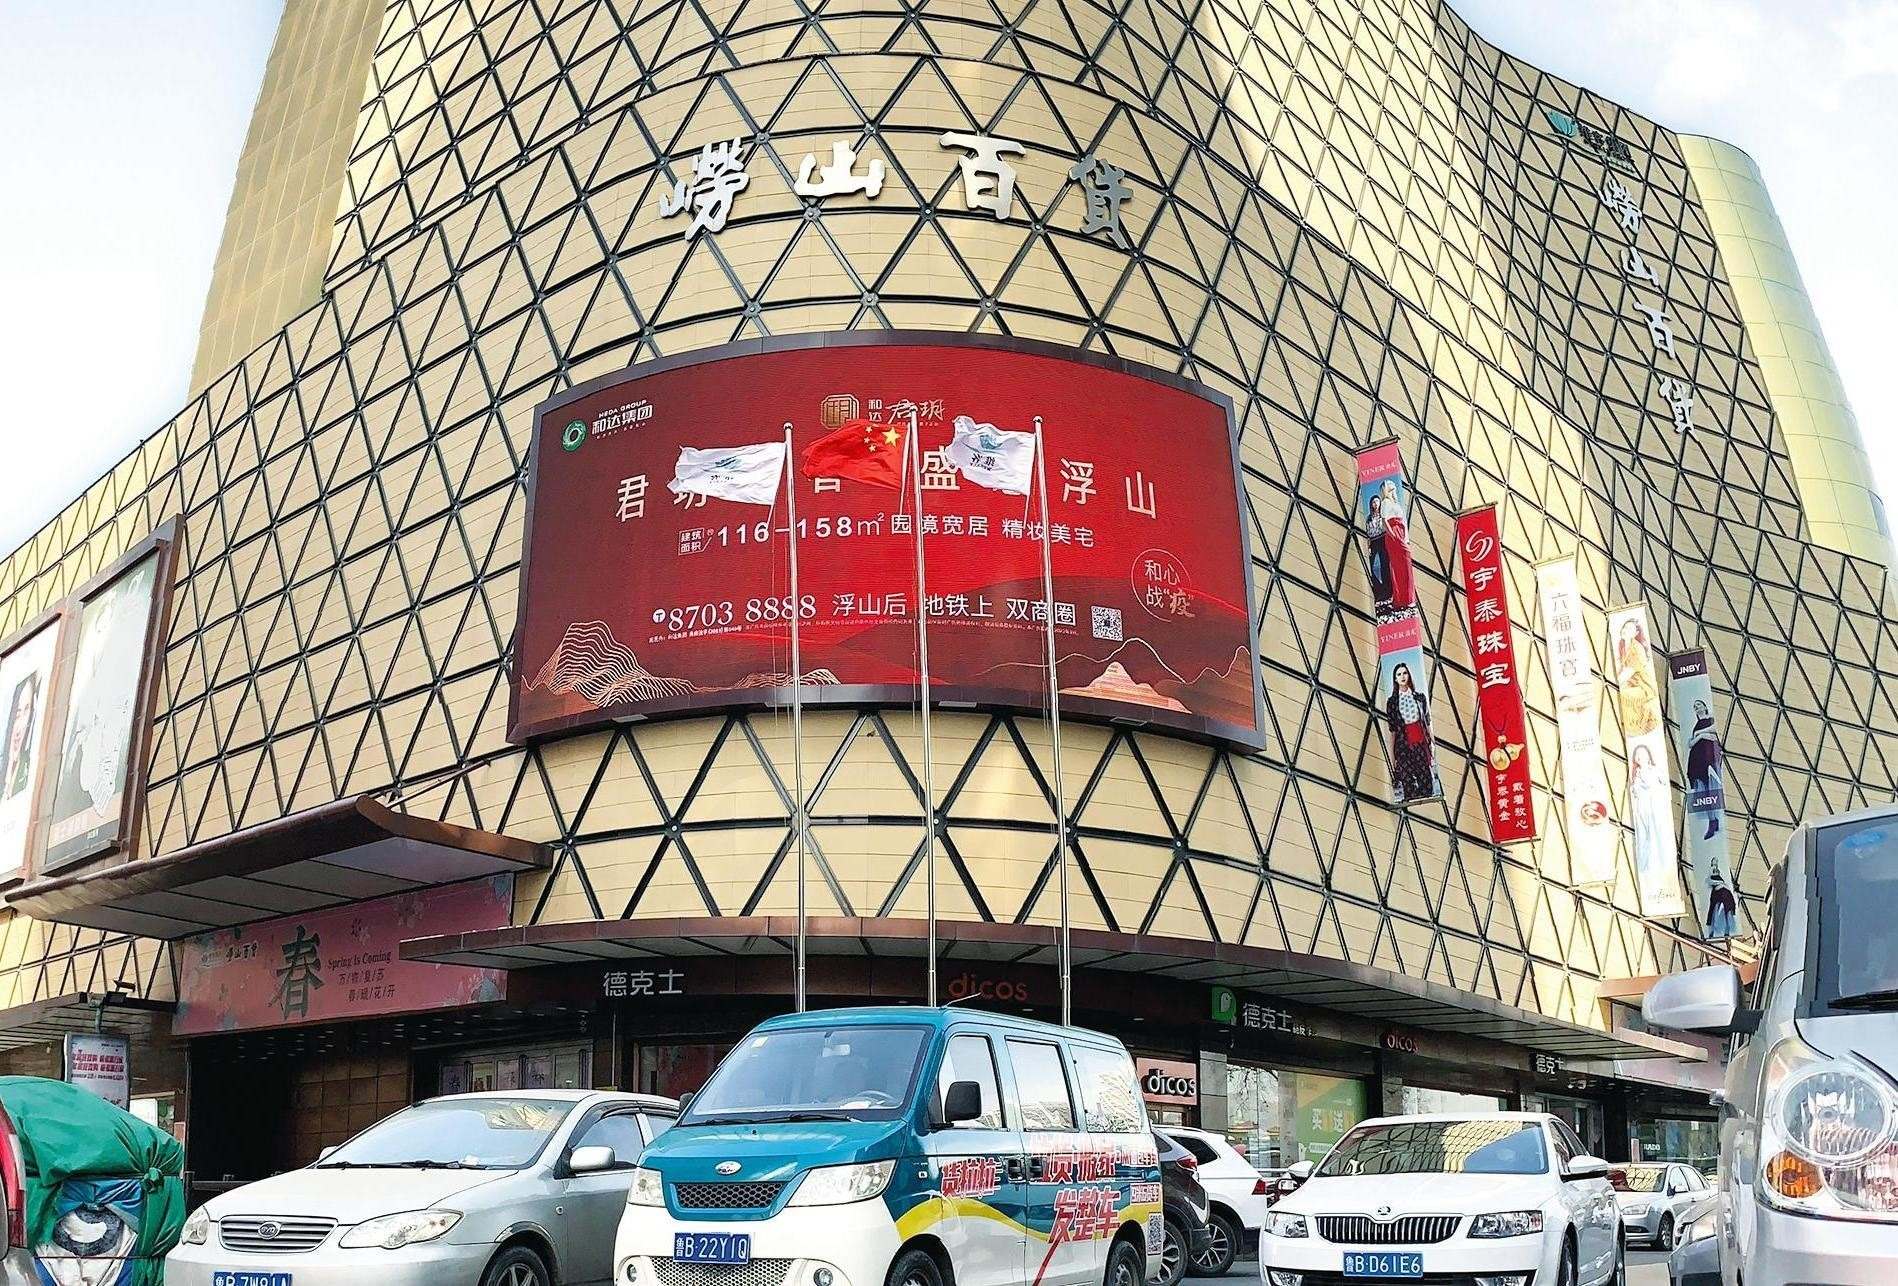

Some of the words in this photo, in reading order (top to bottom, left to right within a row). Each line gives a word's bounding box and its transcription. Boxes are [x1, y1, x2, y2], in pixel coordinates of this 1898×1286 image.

[592, 404, 653, 435] 和达集团
[1143, 558, 1181, 586] 和心
[668, 601, 734, 632] 8703
[745, 594, 817, 622] 8888
[832, 592, 908, 617] 浮山后
[923, 593, 995, 618] 地铁上
[1006, 597, 1077, 626] 双商圈
[1469, 565, 1511, 689] 宇泰珠宝
[1677, 663, 1701, 675] JNBY
[1693, 795, 1719, 807] JNBY
[362, 950, 393, 964] Coming
[268, 925, 325, 1020] 春
[603, 968, 685, 997] 德克士
[948, 972, 1029, 1001] dicos
[1242, 1001, 1293, 1033] 德克士
[1147, 1069, 1196, 1096] dicos
[941, 1157, 1002, 1197] 货拉拉
[1049, 1186, 1122, 1245] 发整车
